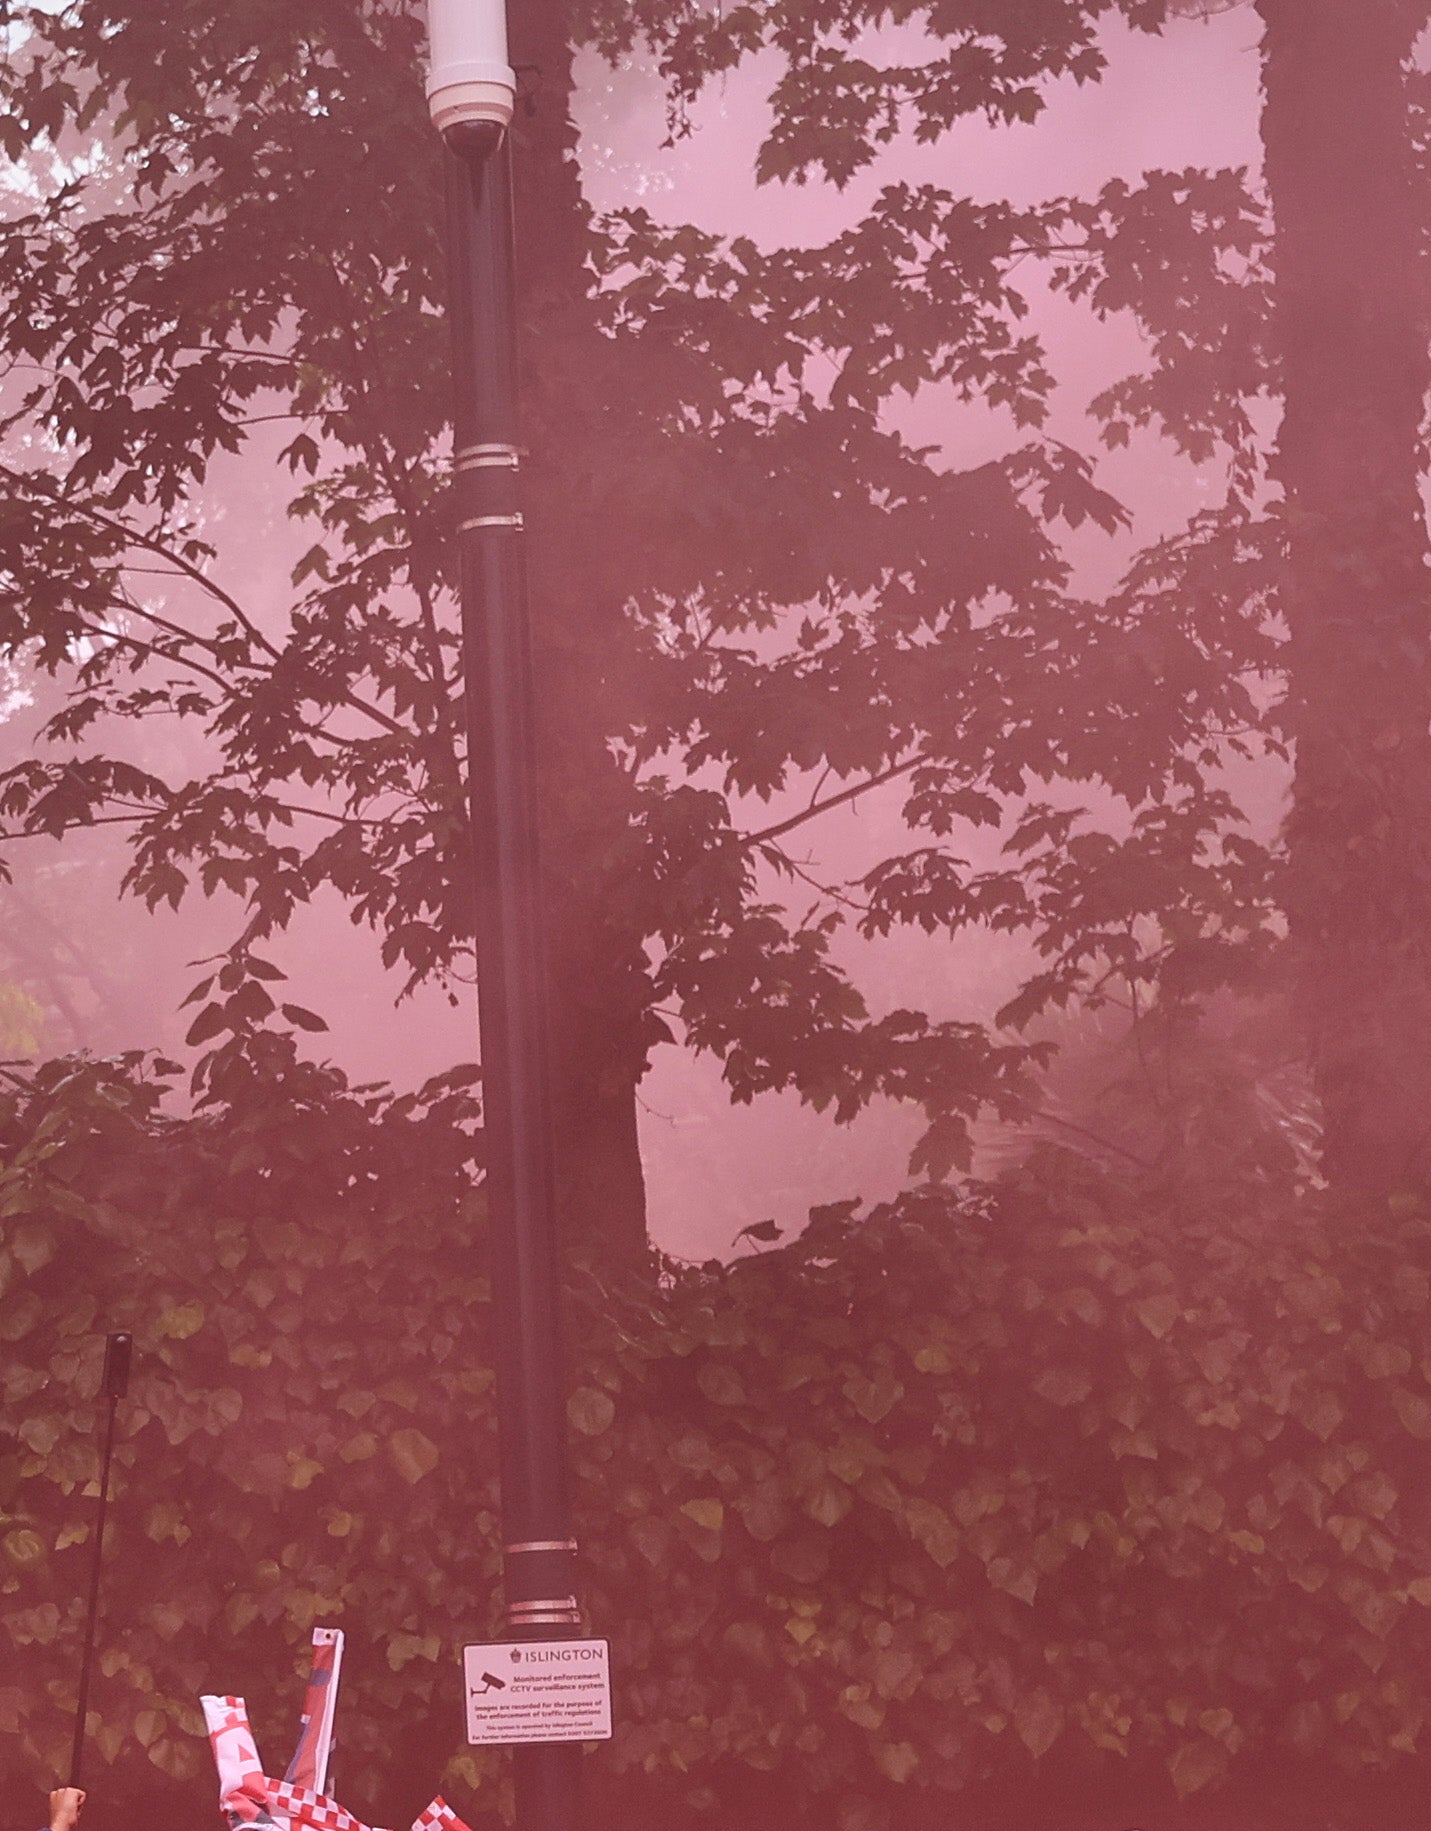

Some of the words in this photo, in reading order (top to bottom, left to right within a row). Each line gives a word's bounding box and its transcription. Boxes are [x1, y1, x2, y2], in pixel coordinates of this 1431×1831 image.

[524, 1648, 604, 1663] ISLINGTON
[513, 1675, 551, 1683] Monitored
[554, 1672, 601, 1681] enforcement
[510, 1685, 530, 1693] CCTV
[533, 1684, 576, 1692] surveillance
[578, 1683, 605, 1691] system
